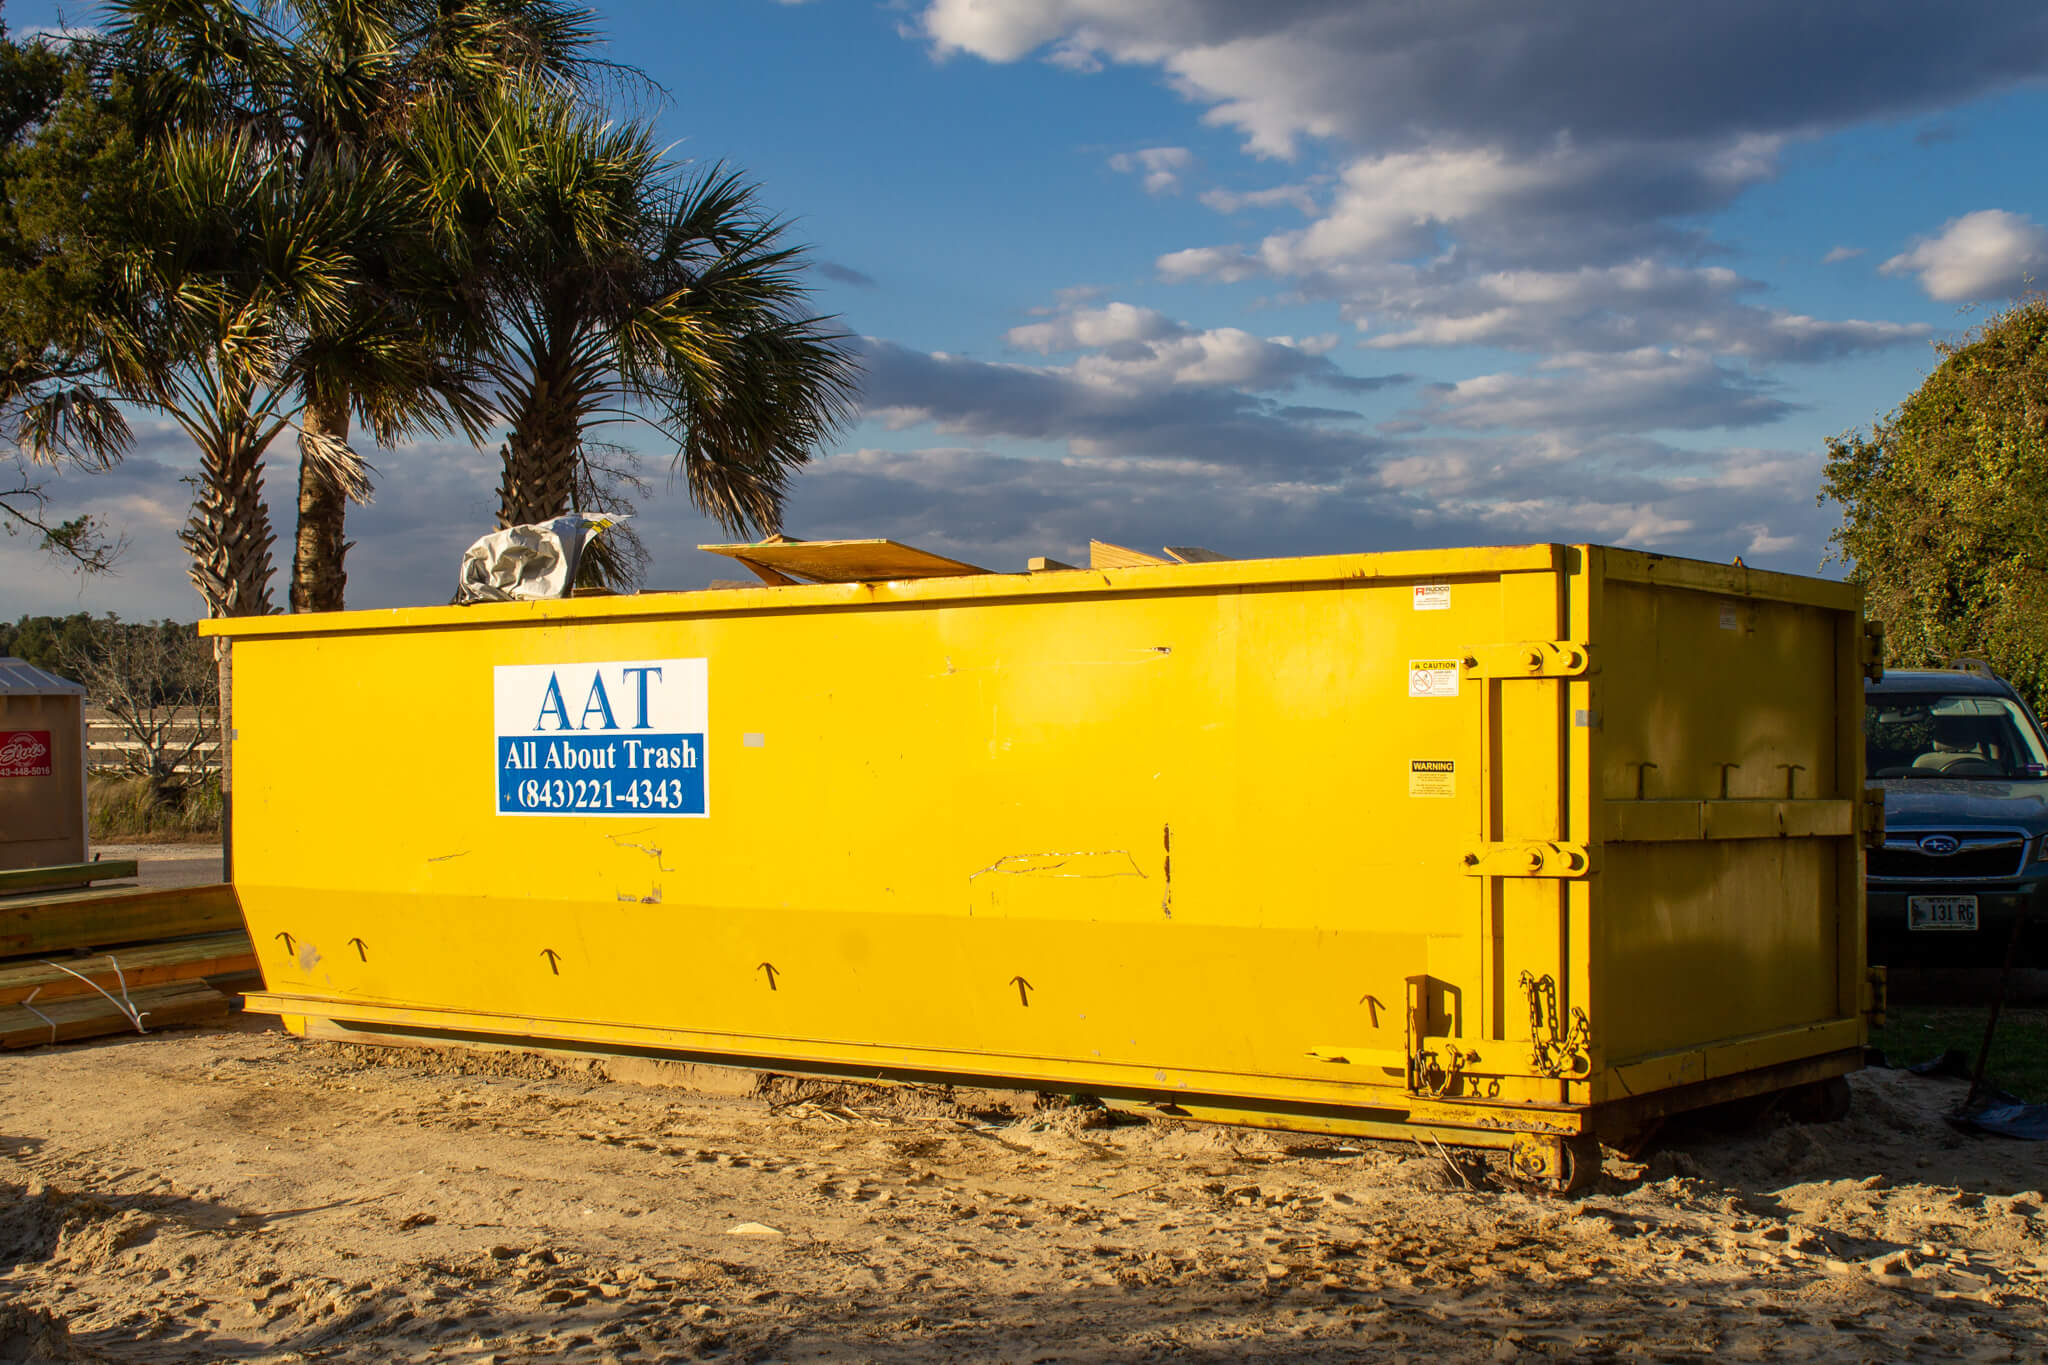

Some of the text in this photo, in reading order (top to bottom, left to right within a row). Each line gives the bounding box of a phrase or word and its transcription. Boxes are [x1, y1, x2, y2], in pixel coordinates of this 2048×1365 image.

[533, 667, 663, 731] AAT
[504, 739, 697, 769] All About Trash
[1413, 762, 1453, 771] WARNING
[518, 779, 683, 809] (843)221-4343
[1931, 904, 1974, 920] 131 RG
